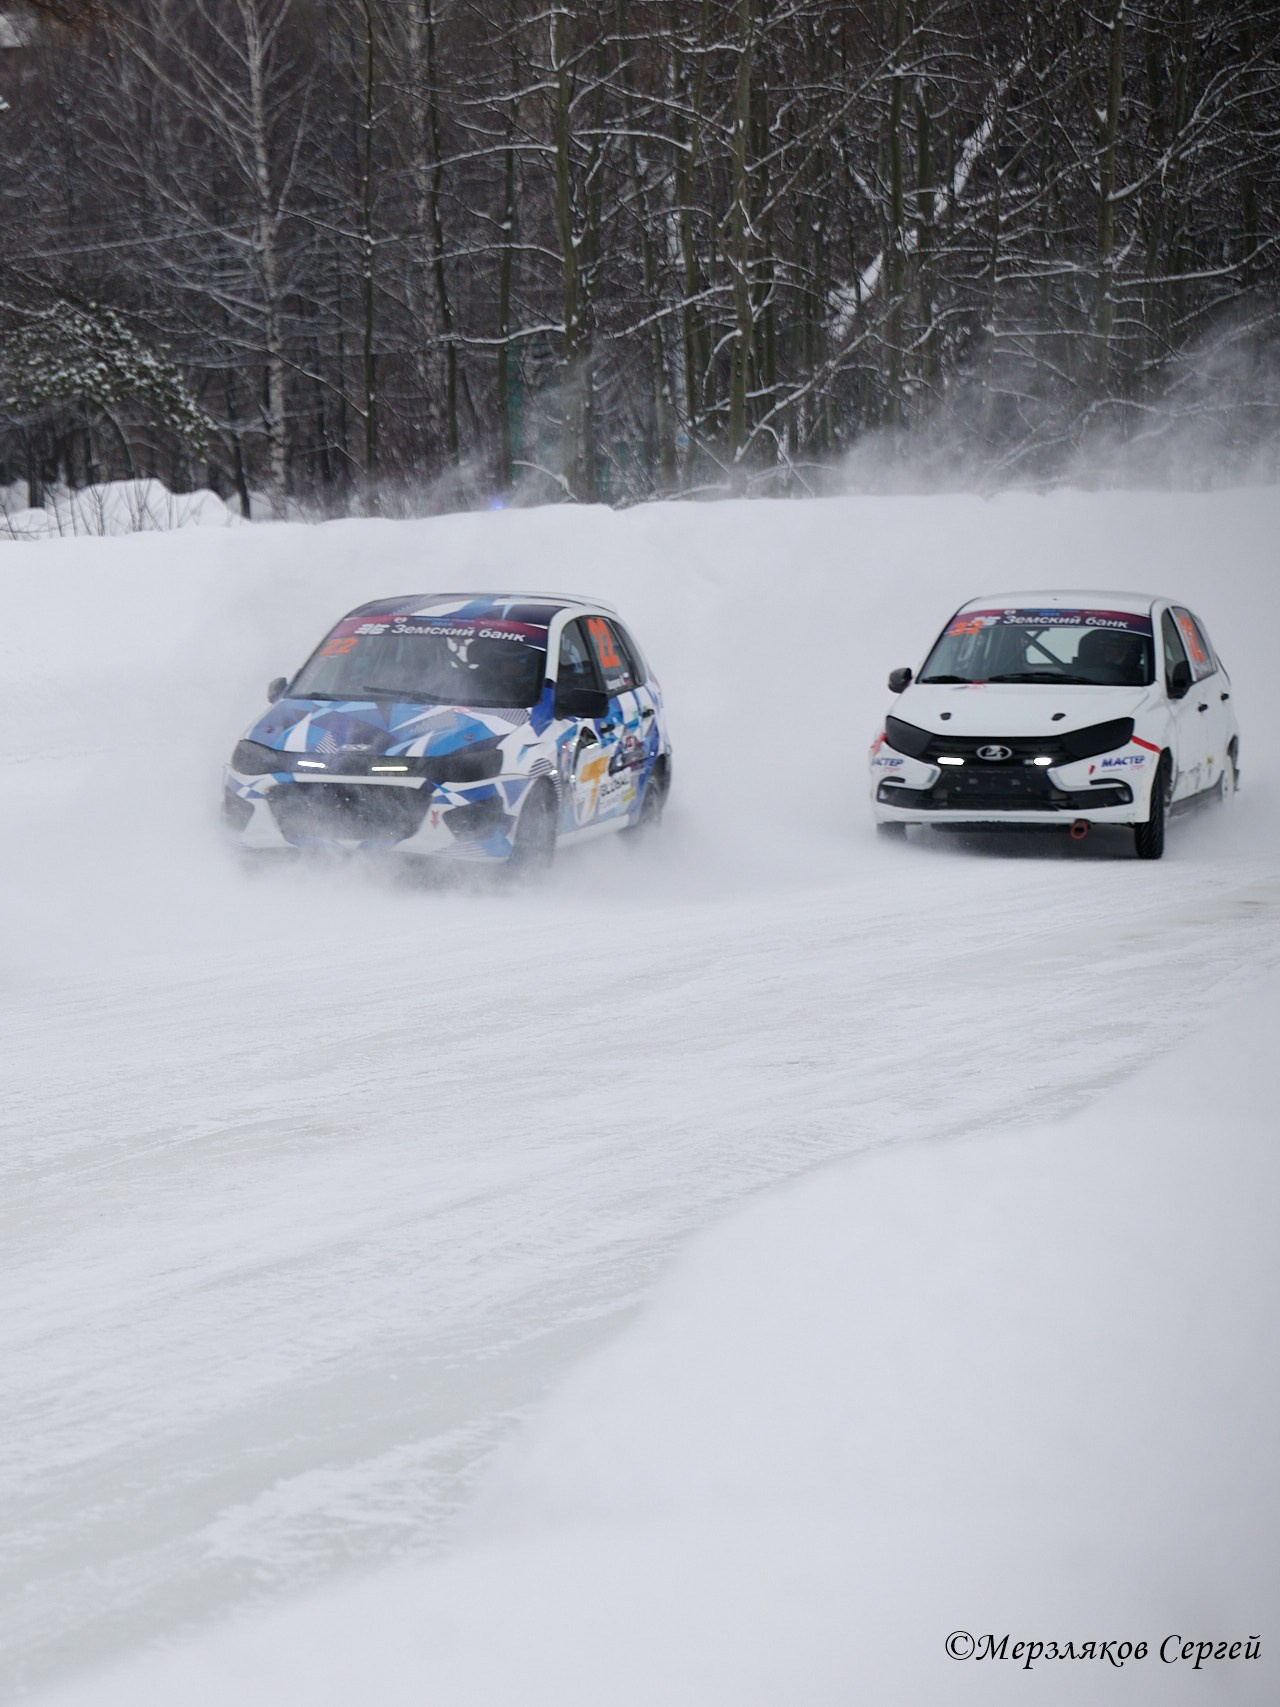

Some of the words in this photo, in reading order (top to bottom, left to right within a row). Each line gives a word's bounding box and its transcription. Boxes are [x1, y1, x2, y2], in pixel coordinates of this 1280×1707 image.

[1003, 615, 1081, 625] Земский
[1085, 616, 1128, 629] банк
[391, 624, 475, 637] Земский
[479, 628, 526, 642] банк
[319, 637, 359, 656] 22
[586, 617, 621, 669] 22
[871, 757, 904, 767] АСТЕР
[1101, 755, 1146, 768] МАСТЕР
